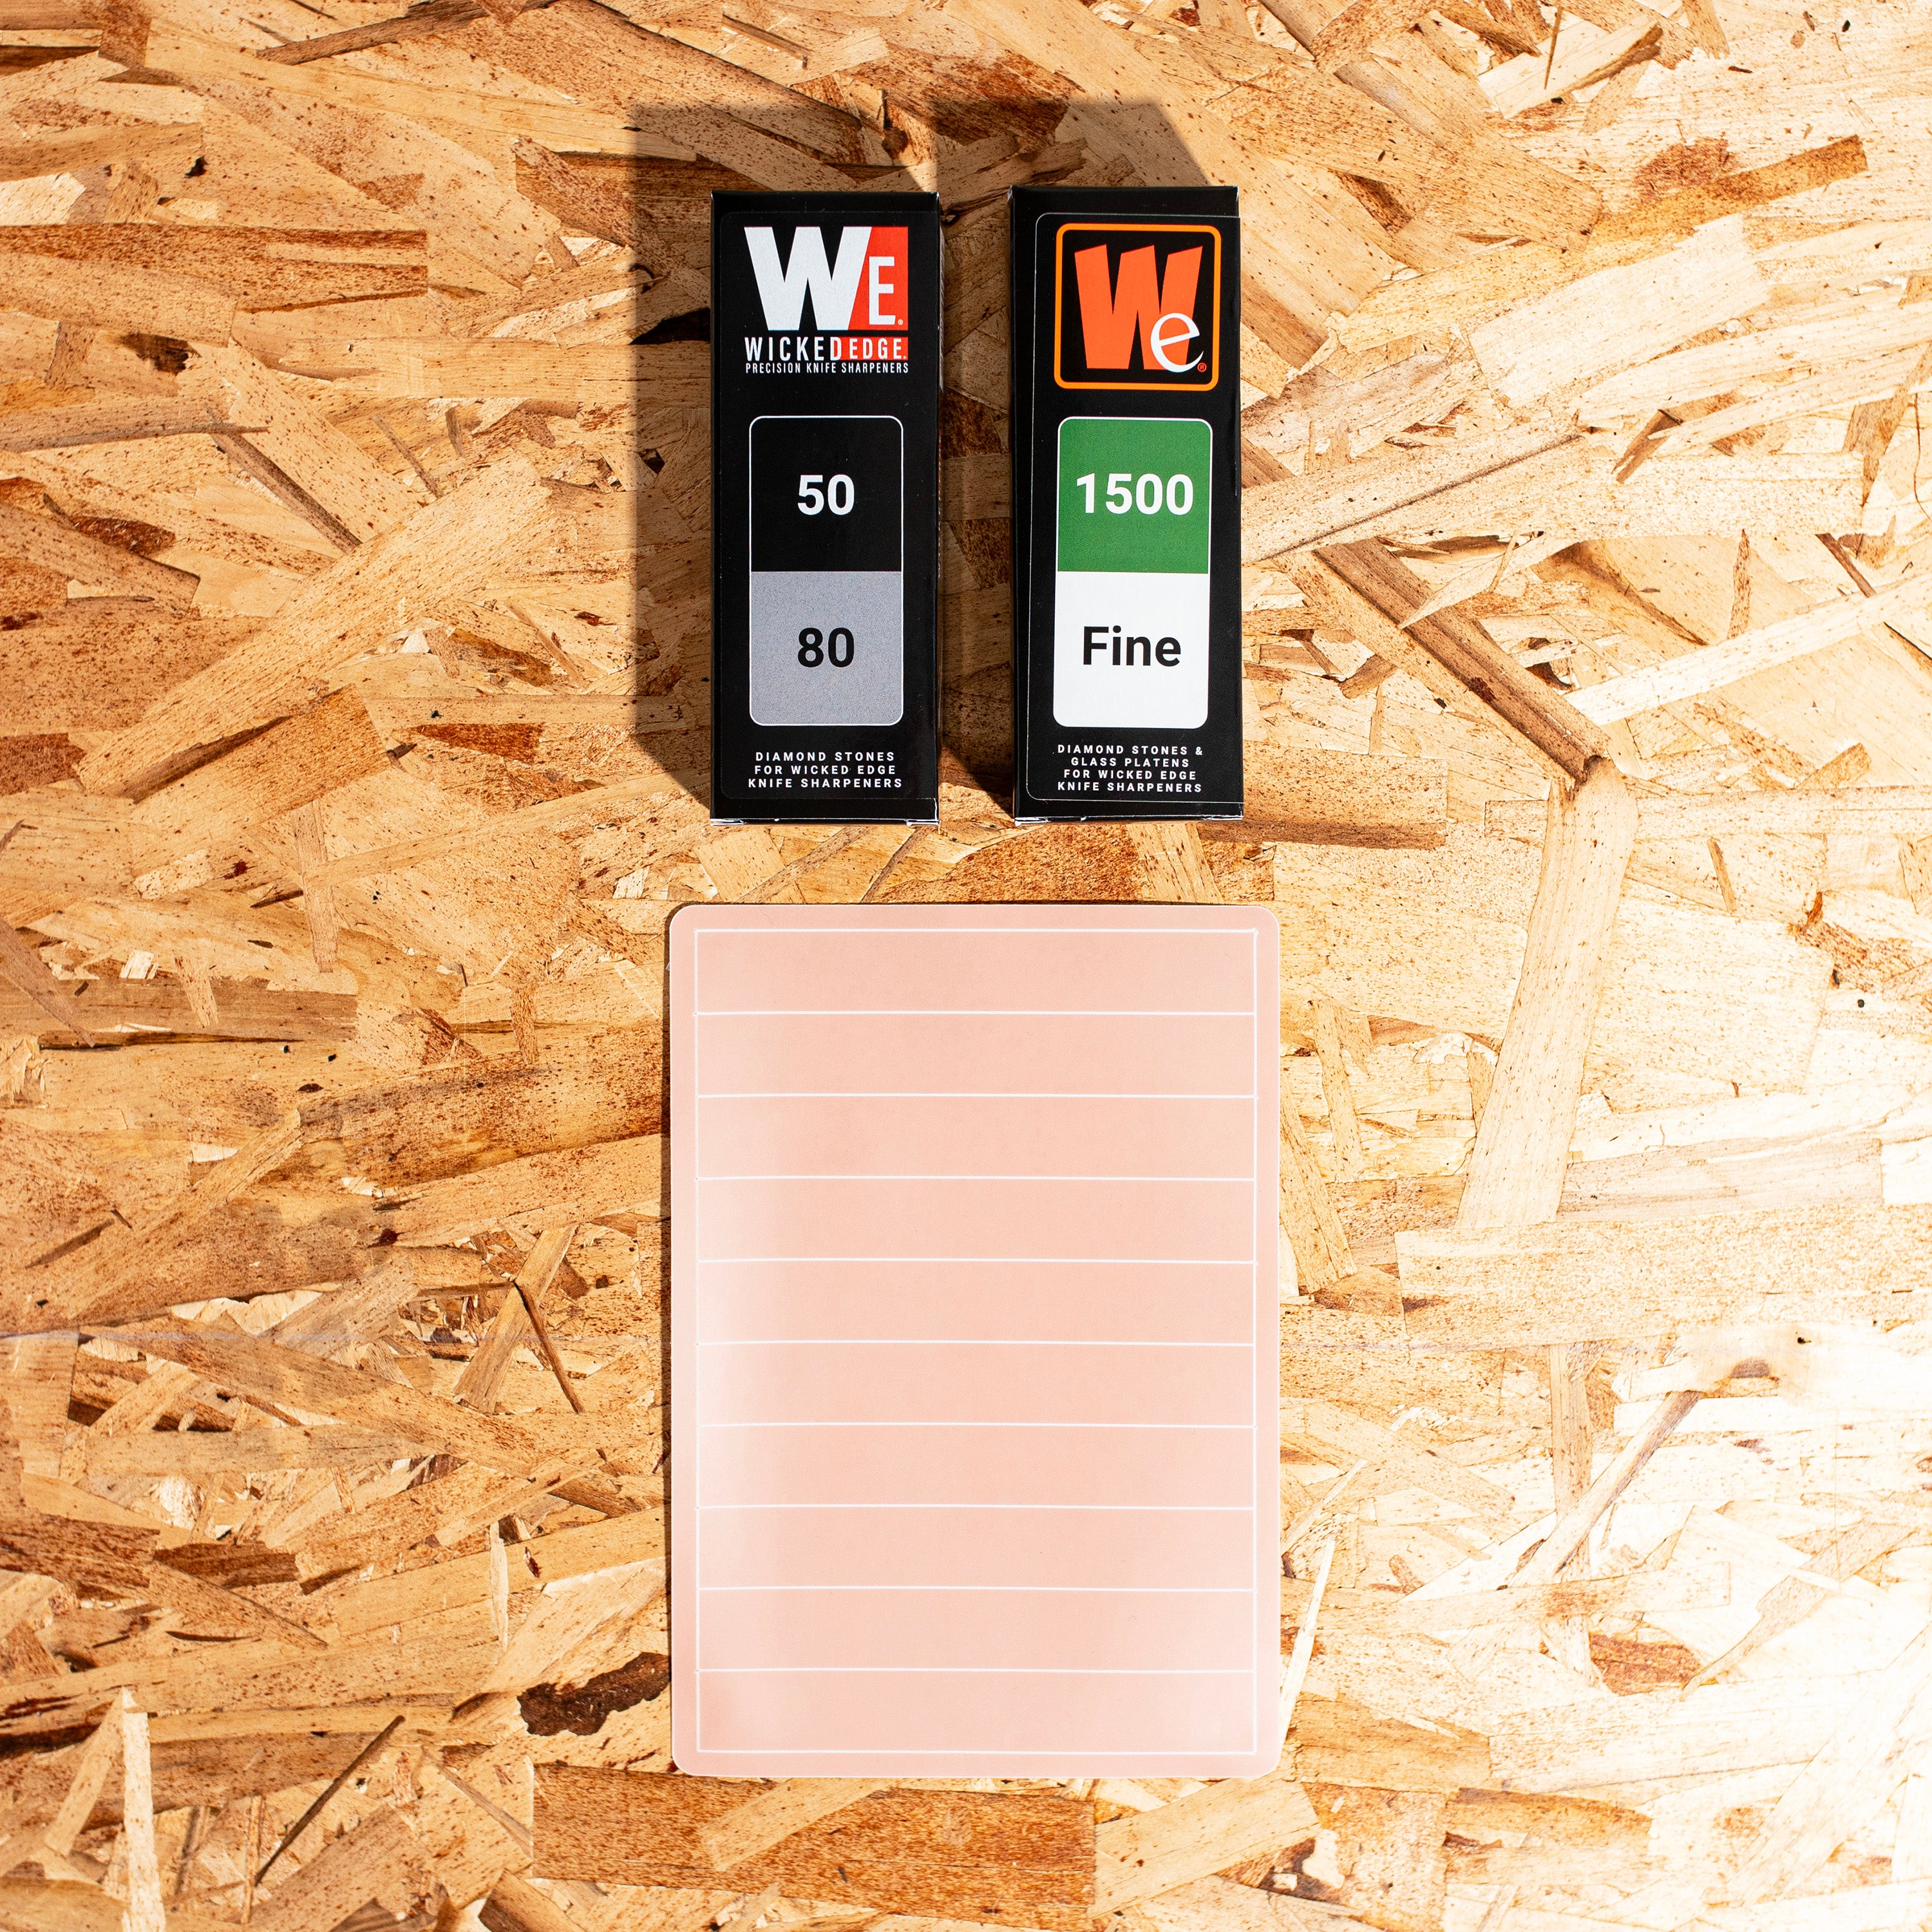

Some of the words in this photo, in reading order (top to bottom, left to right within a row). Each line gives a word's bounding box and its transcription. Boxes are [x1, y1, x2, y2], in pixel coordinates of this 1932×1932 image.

[1074, 244, 1204, 373] We
[746, 363, 801, 374] PRECISION
[806, 363, 837, 374] KNIFE
[841, 362, 909, 374] SHARPENERS
[797, 474, 855, 515] 50
[1076, 473, 1194, 516] 1500
[797, 627, 855, 668] 80
[1083, 625, 1181, 667] Fine
[1057, 744, 1124, 754] DIAMOND
[1132, 745, 1188, 755] STONES
[1195, 746, 1203, 756] &
[755, 752, 827, 762] DIAMOND
[835, 752, 895, 762] STONES
[1071, 757, 1117, 767] GLASS
[1124, 758, 1189, 768] PLATENS
[755, 765, 783, 775] FOR
[791, 765, 849, 775] WICKED
[857, 765, 896, 775] EDGE
[1064, 770, 1090, 779] FOR
[1098, 770, 1153, 781] WICKED
[1160, 771, 1197, 781] EDGE
[748, 778, 793, 789] KNIFE
[800, 778, 902, 789] SHARPENERS
[1057, 781, 1100, 791] KNIFE
[1107, 782, 1202, 793] SHARPENERS
